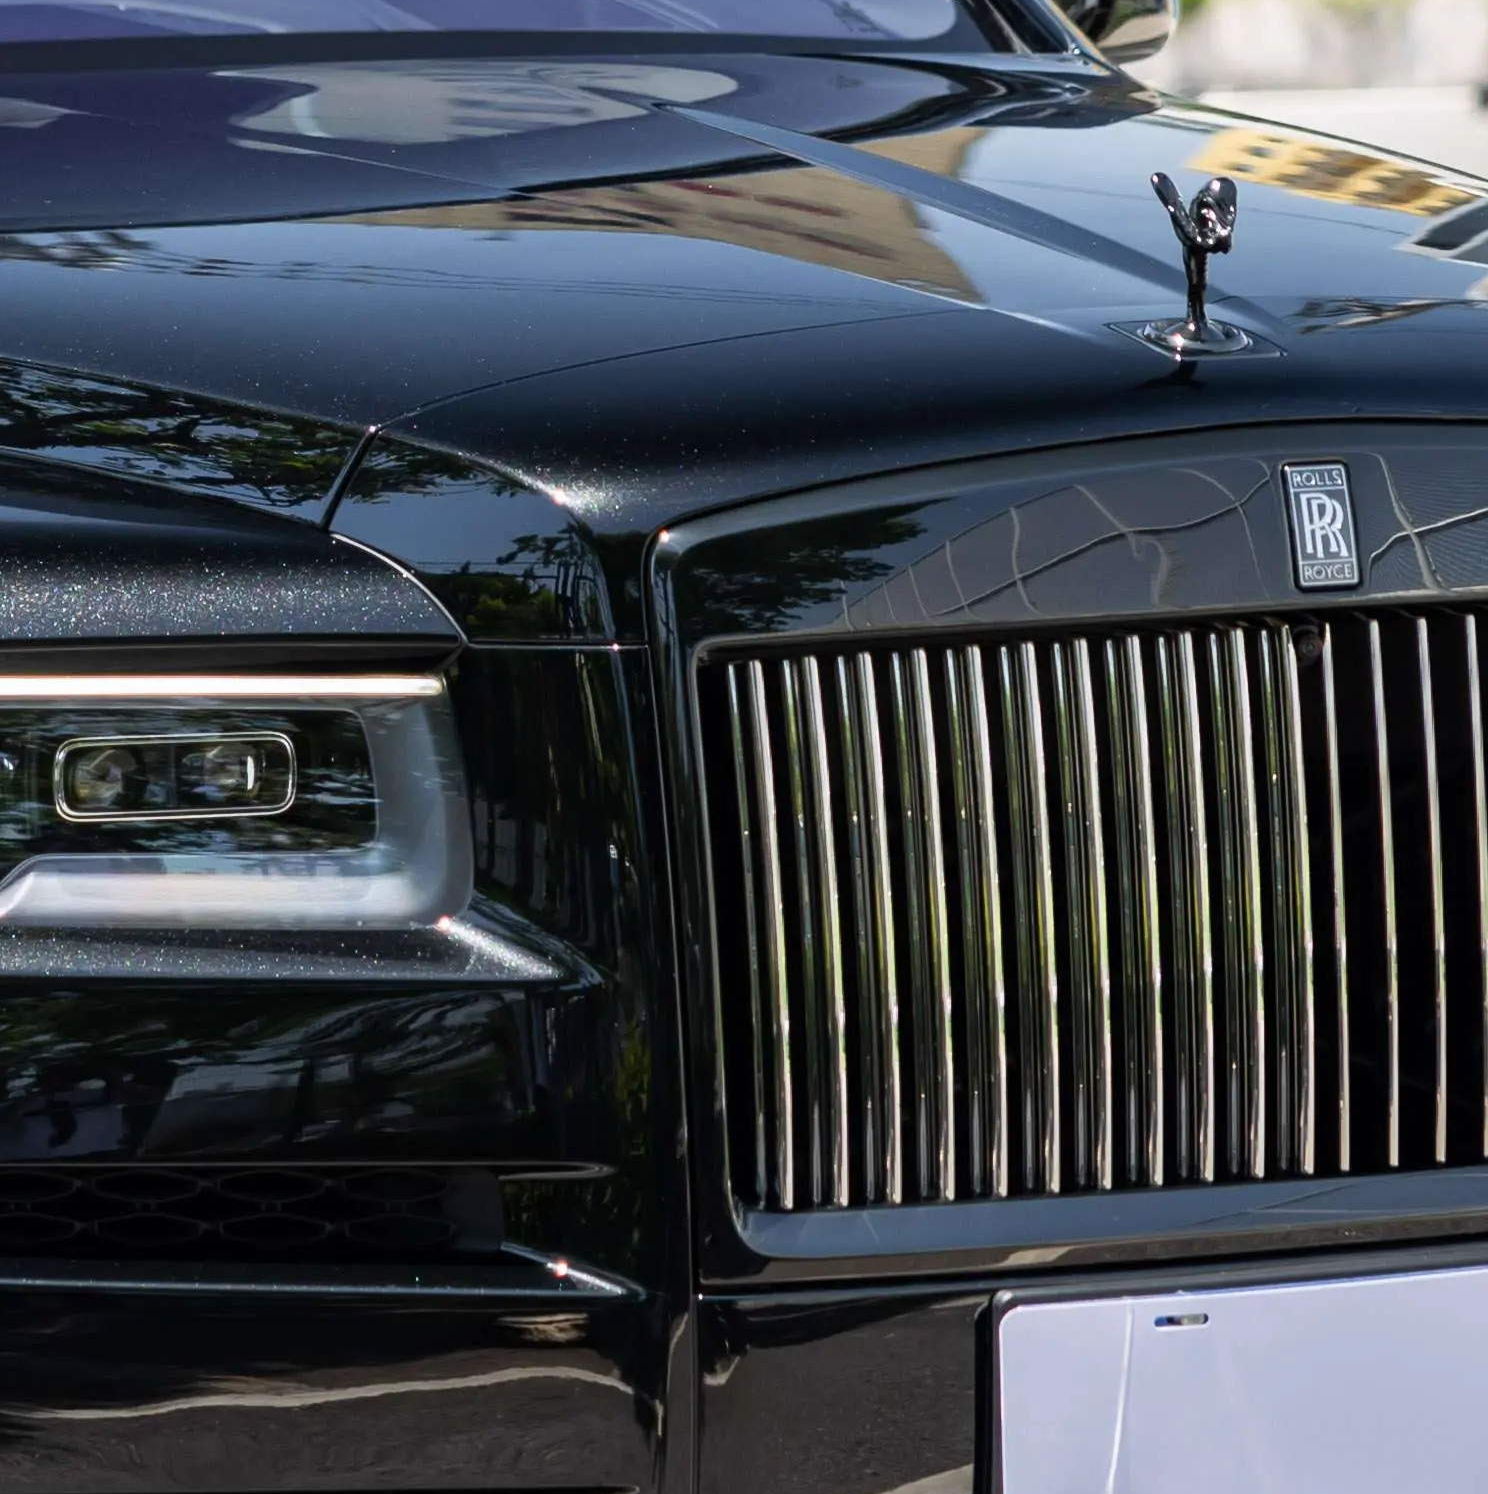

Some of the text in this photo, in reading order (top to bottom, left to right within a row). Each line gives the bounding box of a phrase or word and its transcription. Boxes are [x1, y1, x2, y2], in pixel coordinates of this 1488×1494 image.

[1292, 471, 1343, 487] ROLLS
[1299, 492, 1349, 559] RR
[1304, 563, 1353, 580] ROYCE
